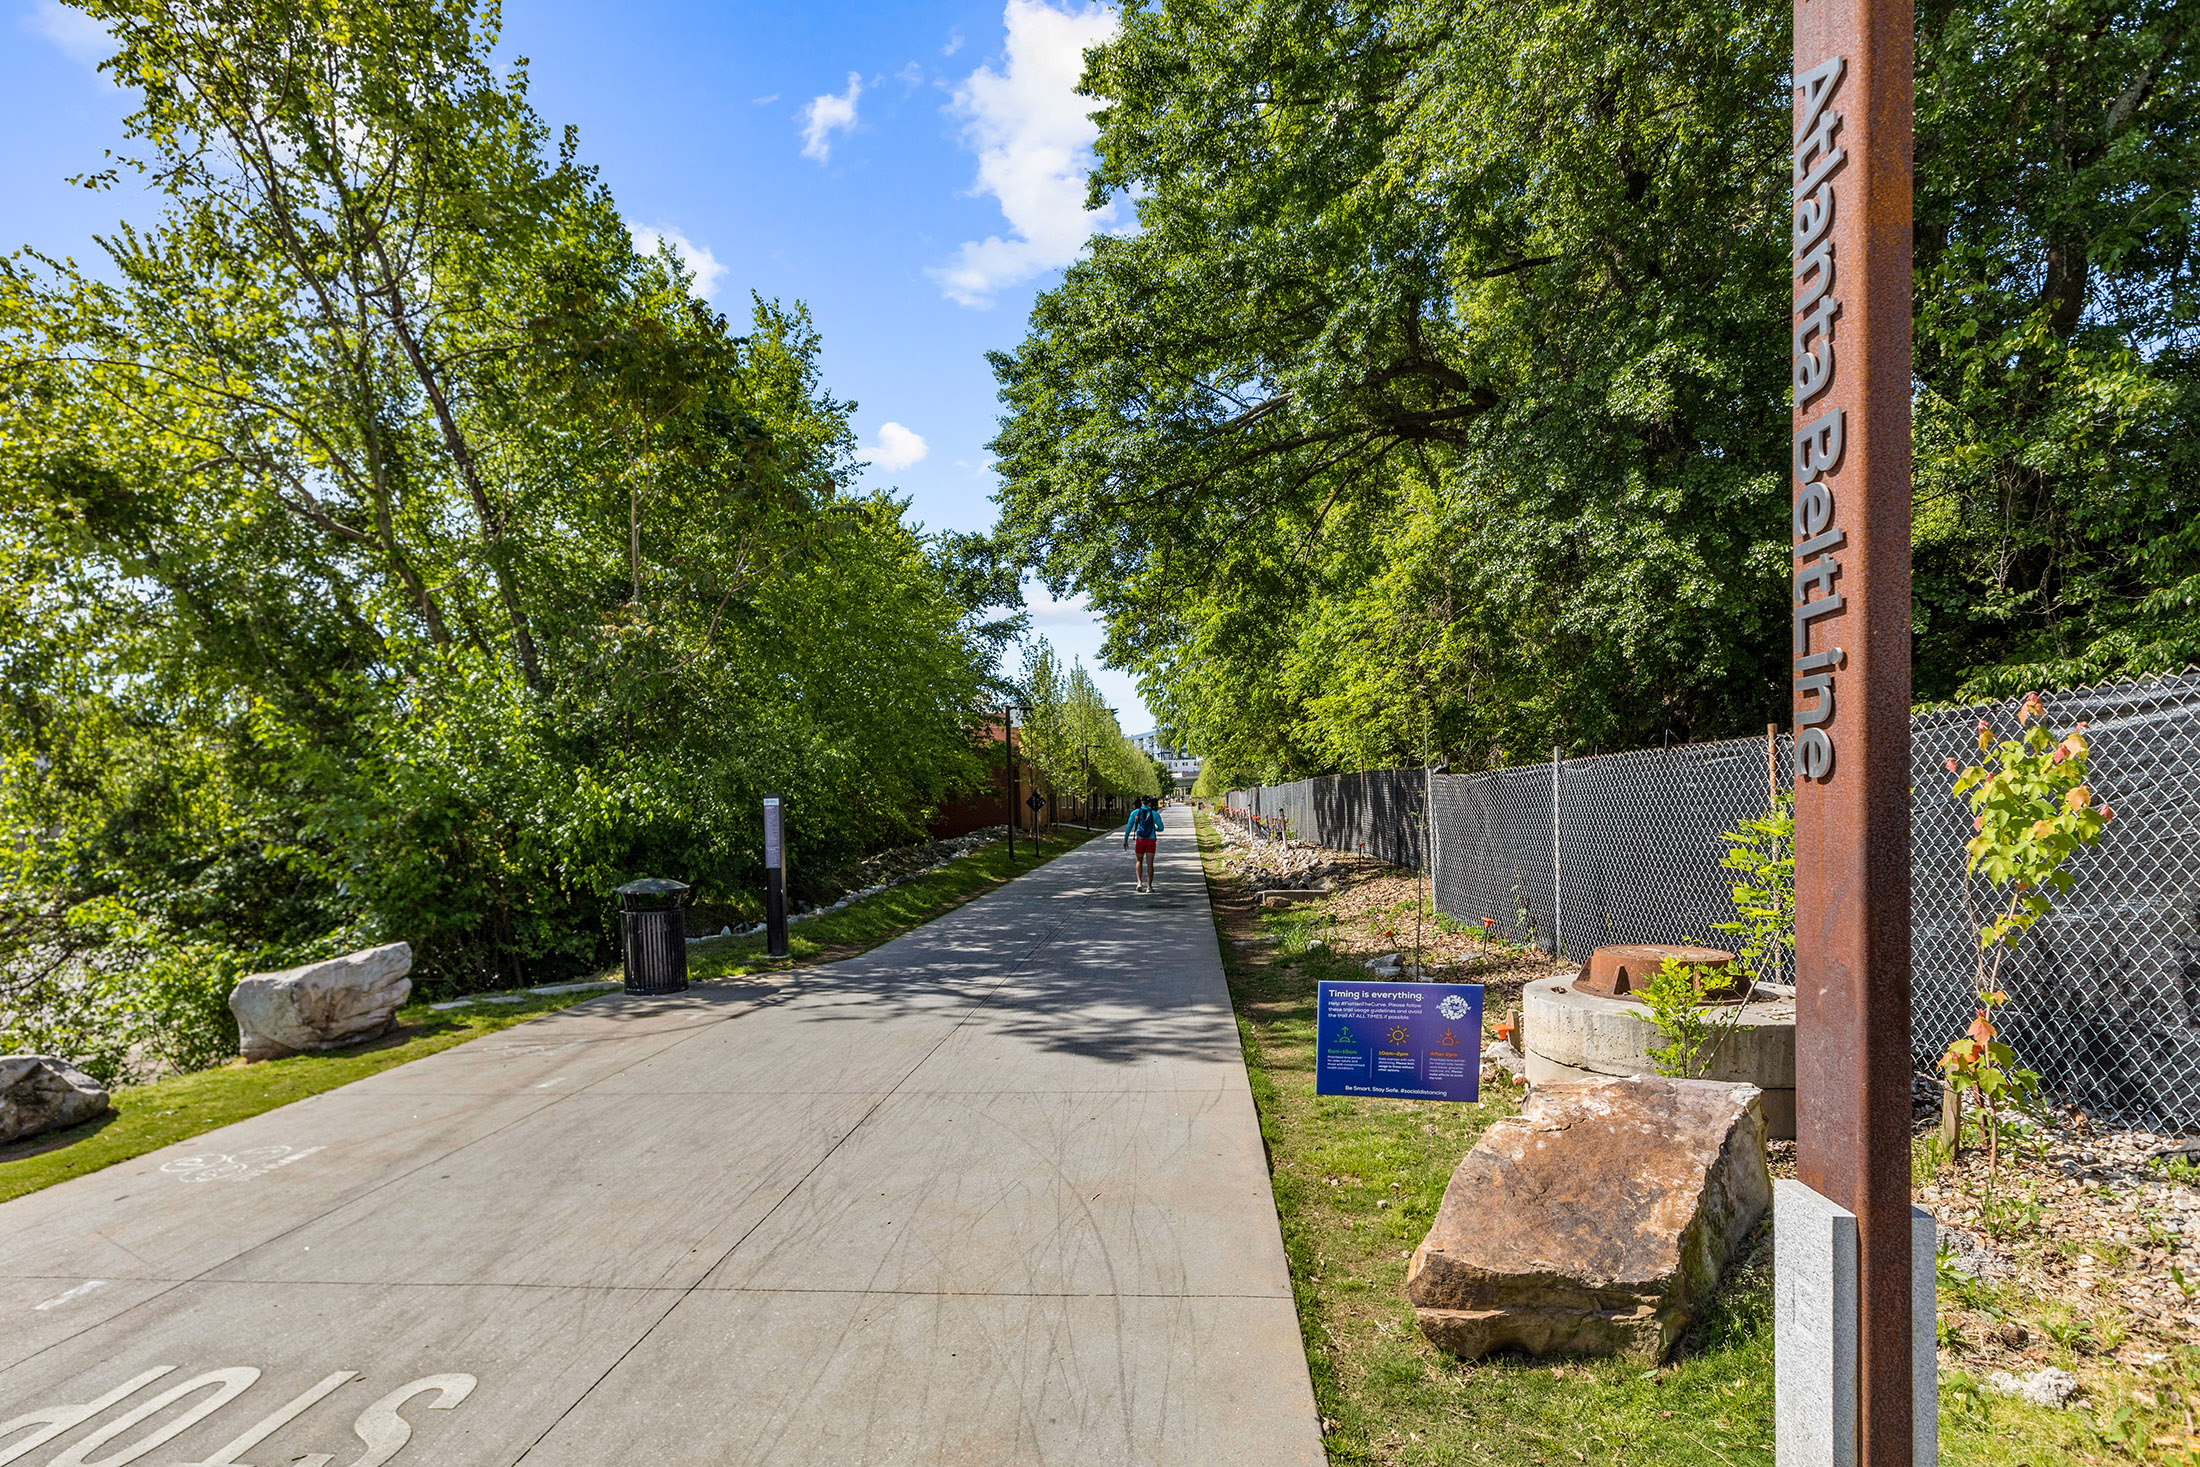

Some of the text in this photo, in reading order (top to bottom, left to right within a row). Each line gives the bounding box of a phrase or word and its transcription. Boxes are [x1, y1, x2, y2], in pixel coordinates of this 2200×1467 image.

[1793, 55, 1843, 779] Atlanta BeltLine
[1329, 989, 1425, 1001] Timing is everything.
[1400, 1088, 1448, 1097] #socialdistancing
